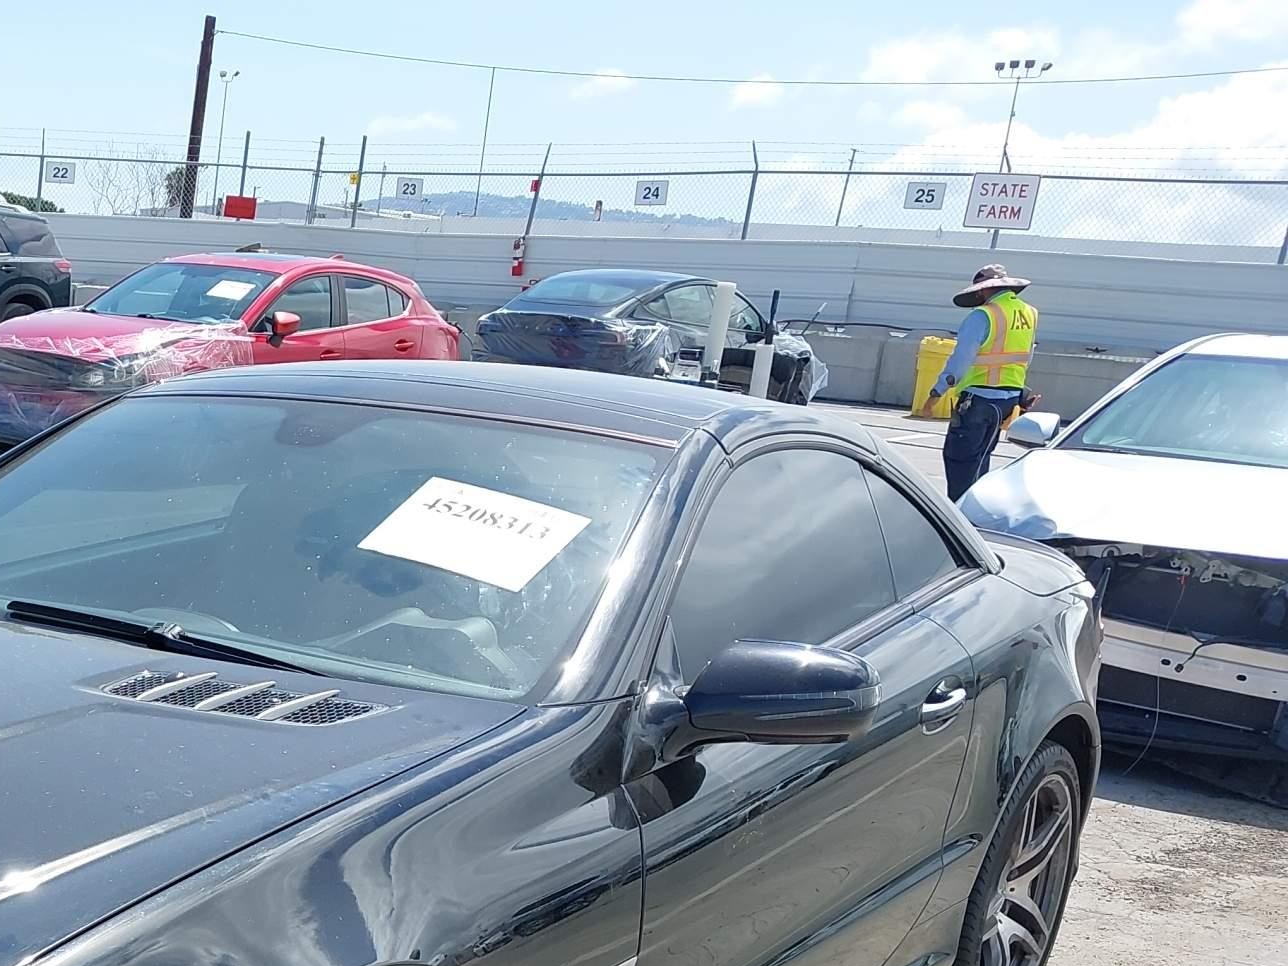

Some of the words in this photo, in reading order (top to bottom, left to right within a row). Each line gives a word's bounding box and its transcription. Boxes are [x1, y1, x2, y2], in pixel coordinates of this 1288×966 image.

[52, 166, 69, 179] 22
[402, 183, 417, 195] 23
[643, 186, 660, 200] 24
[914, 188, 935, 203] 25
[979, 182, 1030, 198] STATE
[977, 204, 1022, 220] FARM
[422, 498, 550, 539] 45208313
